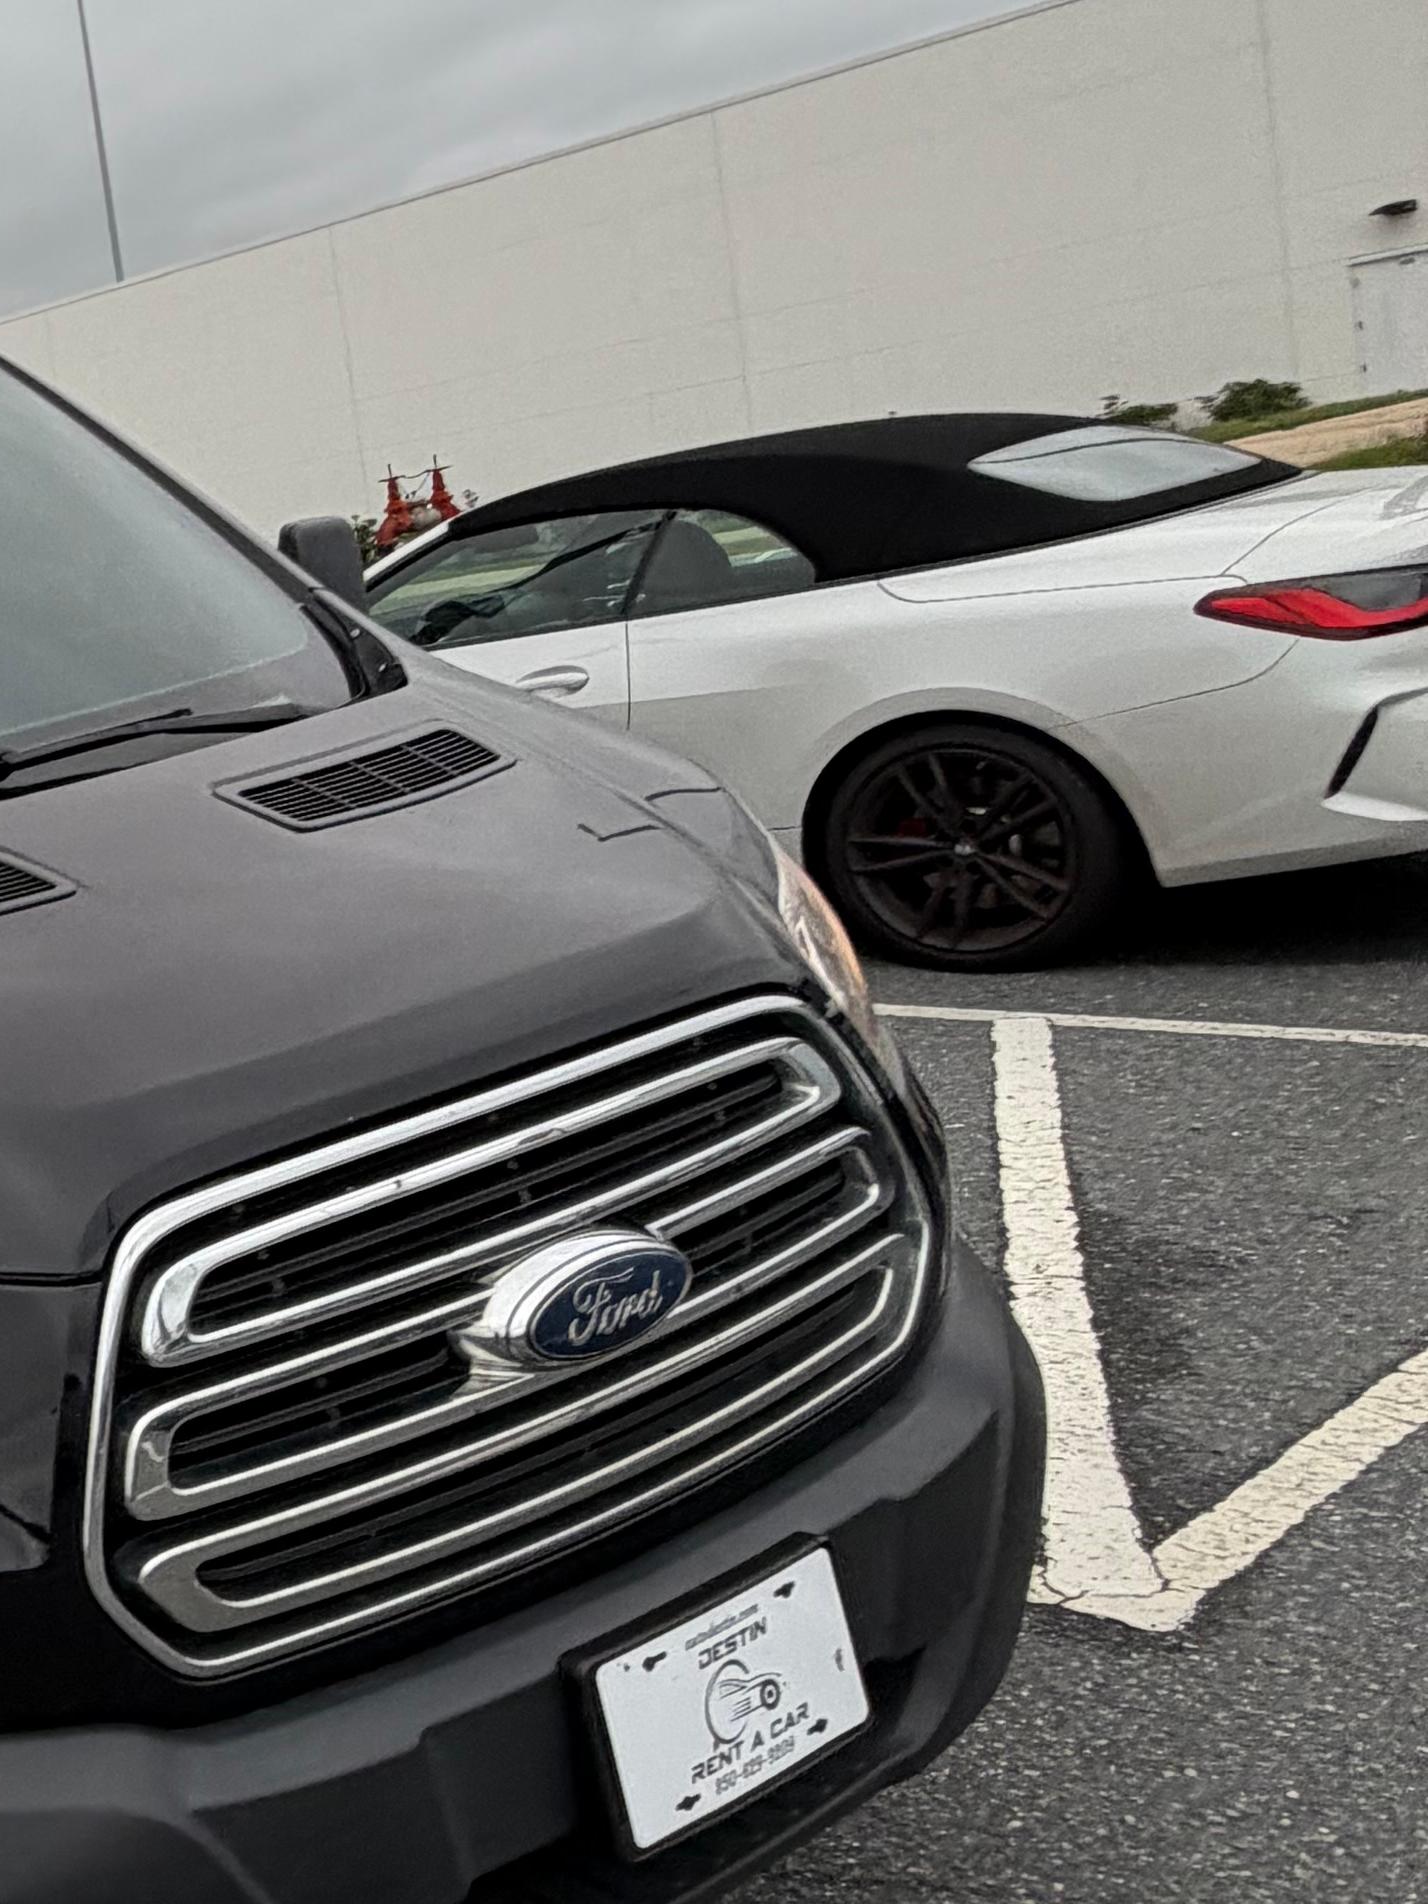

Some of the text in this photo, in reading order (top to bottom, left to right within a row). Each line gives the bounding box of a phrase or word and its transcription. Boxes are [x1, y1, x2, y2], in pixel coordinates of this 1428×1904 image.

[568, 1267, 664, 1346] Ford
[698, 1616, 767, 1670] DESTIN
[691, 1701, 809, 1784] RENT A CAR
